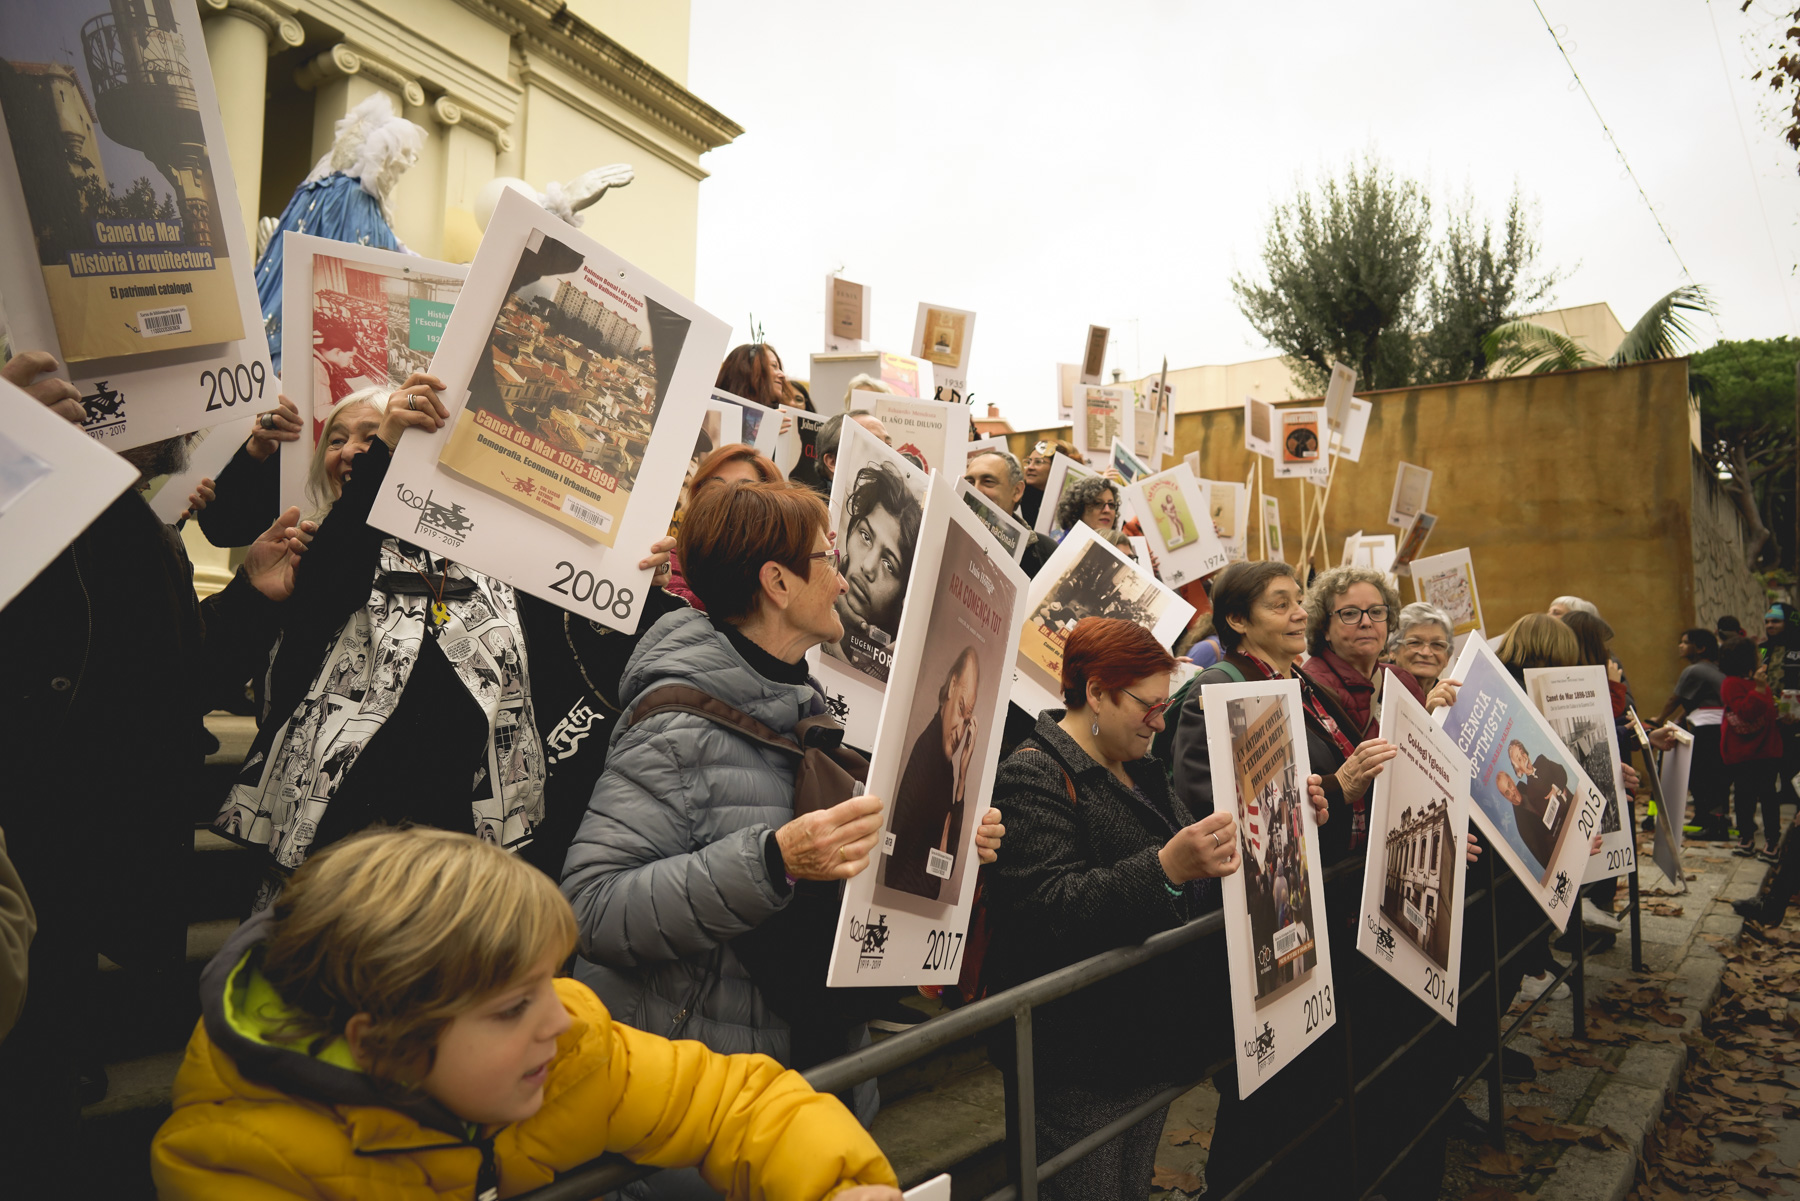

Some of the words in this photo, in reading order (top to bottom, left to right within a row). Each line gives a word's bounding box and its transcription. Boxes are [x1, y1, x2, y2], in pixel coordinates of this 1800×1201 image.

[96, 222, 138, 243] Canet
[140, 222, 155, 242] de
[155, 222, 181, 242] Mar
[70, 252, 128, 275] Història
[128, 252, 135, 271] i
[137, 250, 212, 272] arquitectura
[109, 286, 118, 299] El
[118, 284, 157, 299] patrimoni
[158, 282, 193, 295] catalogat
[415, 317, 442, 328] l'Escola
[200, 361, 266, 412] 2009
[944, 378, 964, 388] 1935
[110, 424, 127, 438] 2019
[800, 418, 814, 429] John
[889, 416, 903, 425] AÑO
[904, 418, 916, 426] DEL
[916, 419, 943, 429] DILUVIO
[476, 409, 515, 440] Canet
[513, 430, 531, 447] de
[531, 438, 557, 458] Mar
[558, 451, 617, 491] 1975-1998
[477, 433, 522, 463] Demografia,
[523, 457, 558, 480] Economia
[563, 477, 602, 502] Urbanisme
[419, 525, 438, 539] 1919
[442, 535, 461, 548] 2019
[990, 524, 1016, 549] nacionals
[1203, 553, 1225, 569] 1974
[548, 560, 634, 620] 2008
[949, 572, 963, 601] ARA
[962, 585, 991, 628] COMENÇA
[990, 610, 1002, 635] TOT
[850, 635, 874, 653] EUGENI
[1265, 707, 1284, 731] CONTRA
[1458, 690, 1491, 753] CIÈNCIA
[1268, 724, 1284, 747] DRETA
[1471, 697, 1508, 779] OPTIMISTA
[1578, 788, 1600, 841] 2015
[1606, 847, 1633, 871] 2012
[922, 929, 963, 971] 2017
[1424, 967, 1455, 1012] 2014
[1304, 984, 1332, 1034] 2013
